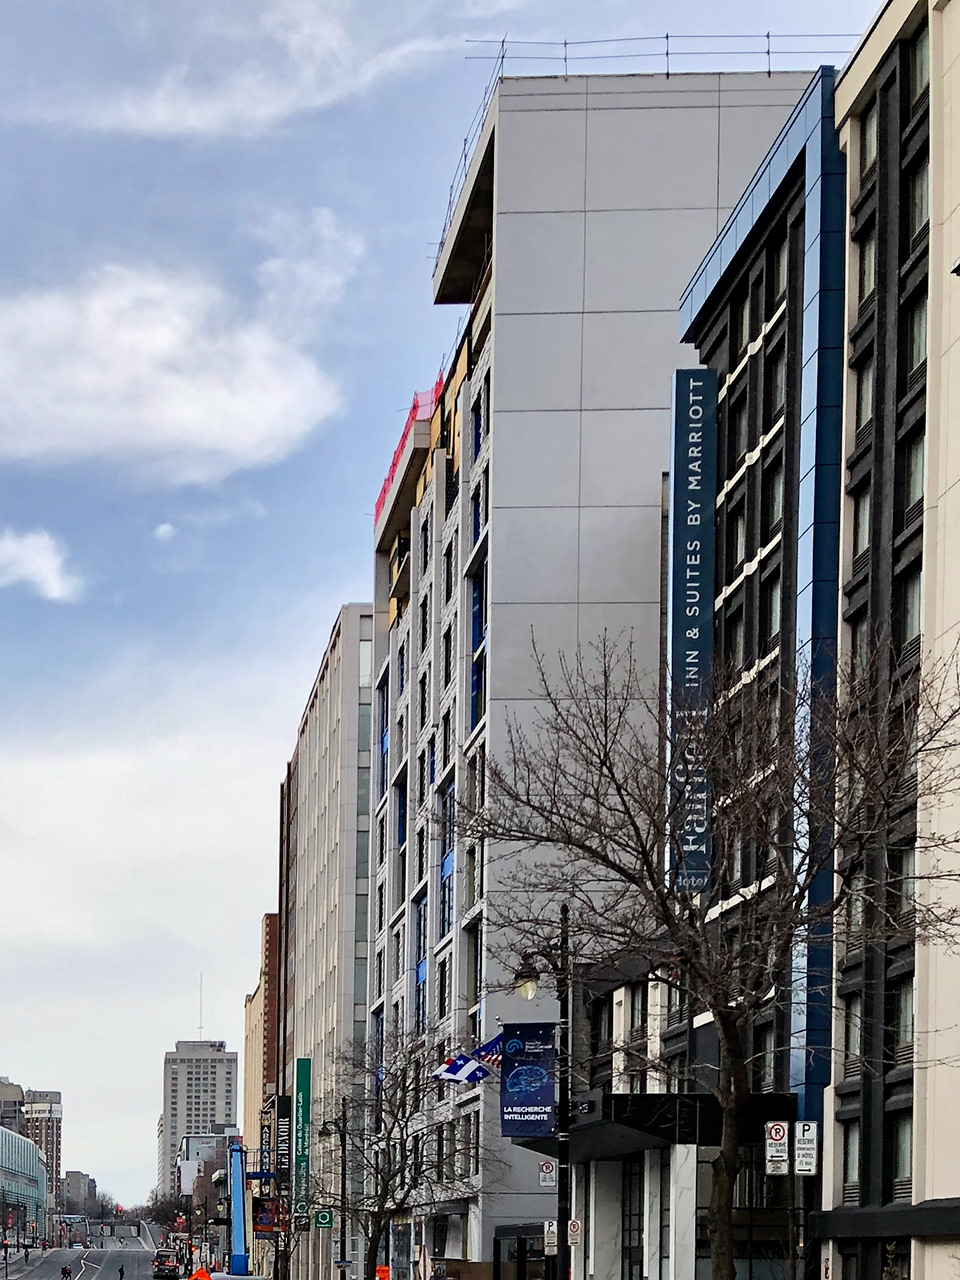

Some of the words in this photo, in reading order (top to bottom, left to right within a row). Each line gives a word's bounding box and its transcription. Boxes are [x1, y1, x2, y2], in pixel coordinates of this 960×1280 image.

[688, 378, 704, 490] MARRIOTT
[687, 500, 701, 526] BY
[686, 540, 701, 617] SUITES
[685, 627, 700, 640] &
[685, 650, 699, 687] INN
[278, 1117, 290, 1154] DEVOIR
[278, 1155, 289, 1169] LE
